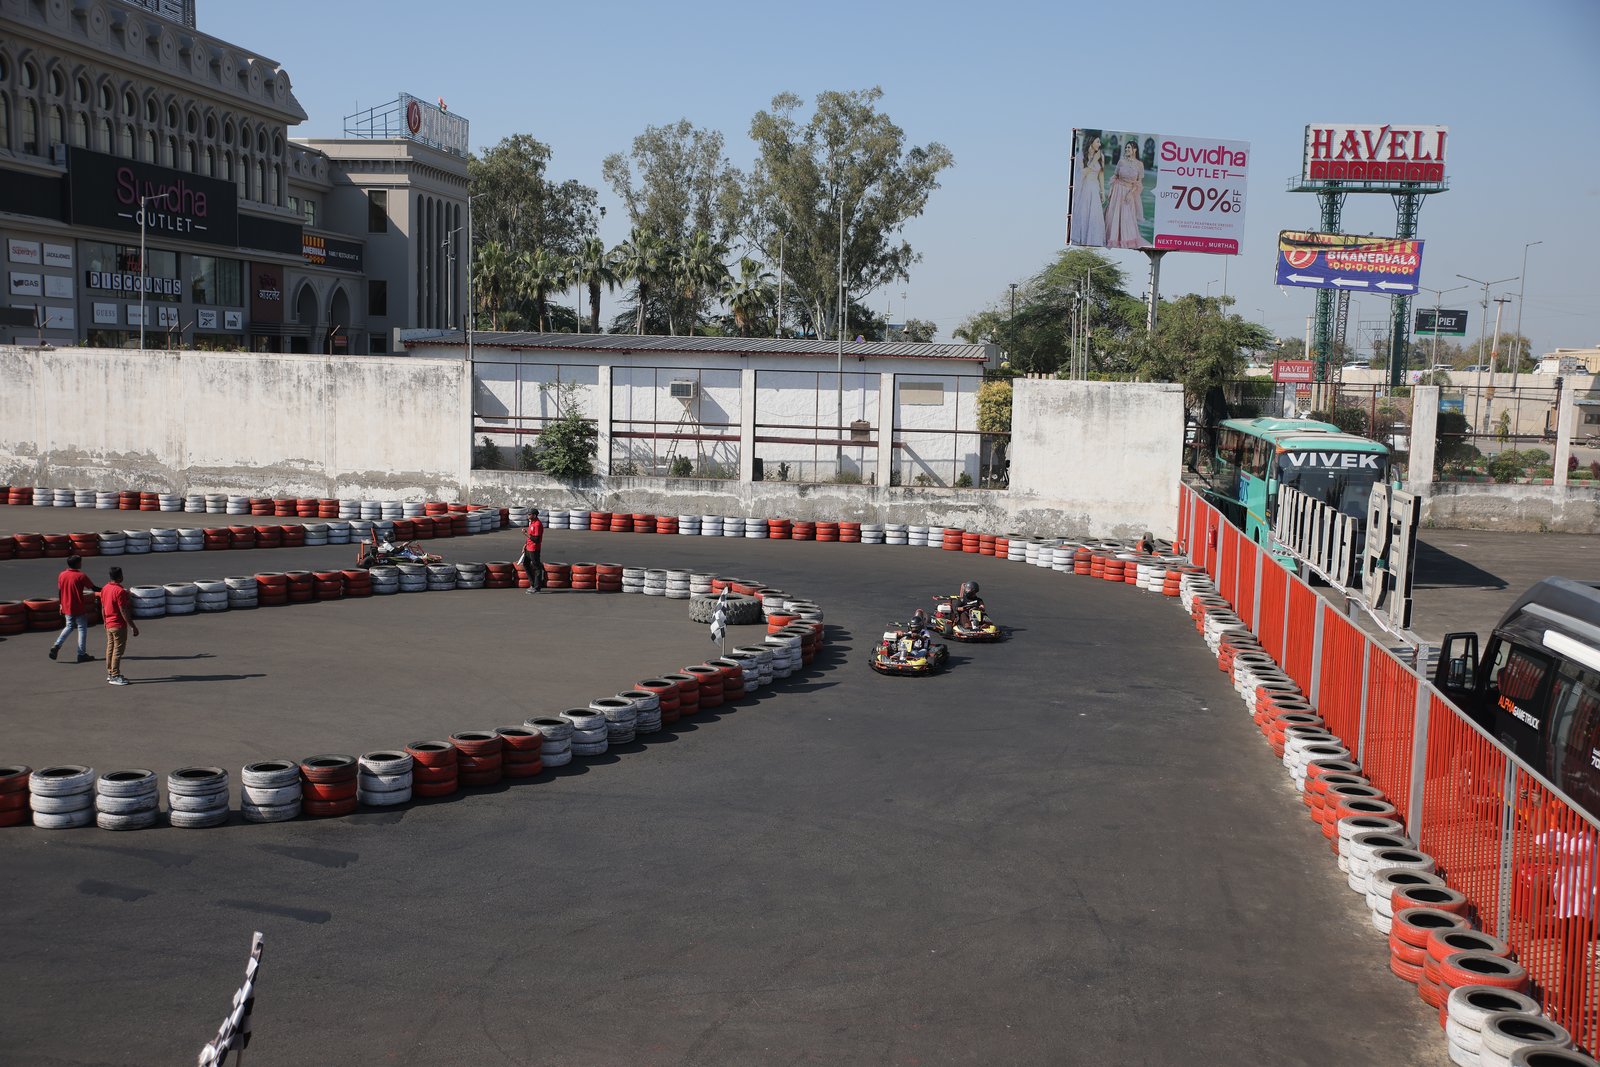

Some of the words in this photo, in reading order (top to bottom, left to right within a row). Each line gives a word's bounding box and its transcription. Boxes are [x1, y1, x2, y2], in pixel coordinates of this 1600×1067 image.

[1311, 124, 1447, 161] HAVELI
[1160, 141, 1246, 167] Suvidha
[1176, 166, 1229, 179] OUTLET
[116, 166, 207, 217] Suvidha
[1160, 191, 1179, 200] UPTO
[1172, 185, 1232, 213] 70%
[1231, 189, 1242, 213] OFF
[136, 211, 192, 232] OUTLET
[1157, 238, 1173, 246] NEXT
[1183, 240, 1204, 248] HAVELI
[1208, 241, 1236, 250] MURTHAL
[1327, 251, 1417, 266] BIKANERVALA
[23, 280, 39, 288] GAS
[91, 270, 182, 294] DISCOUNTS
[96, 308, 115, 318] GUESS
[1438, 316, 1457, 327] PIET
[1279, 365, 1310, 373] HAVELI
[1287, 452, 1379, 469] VIVEK
